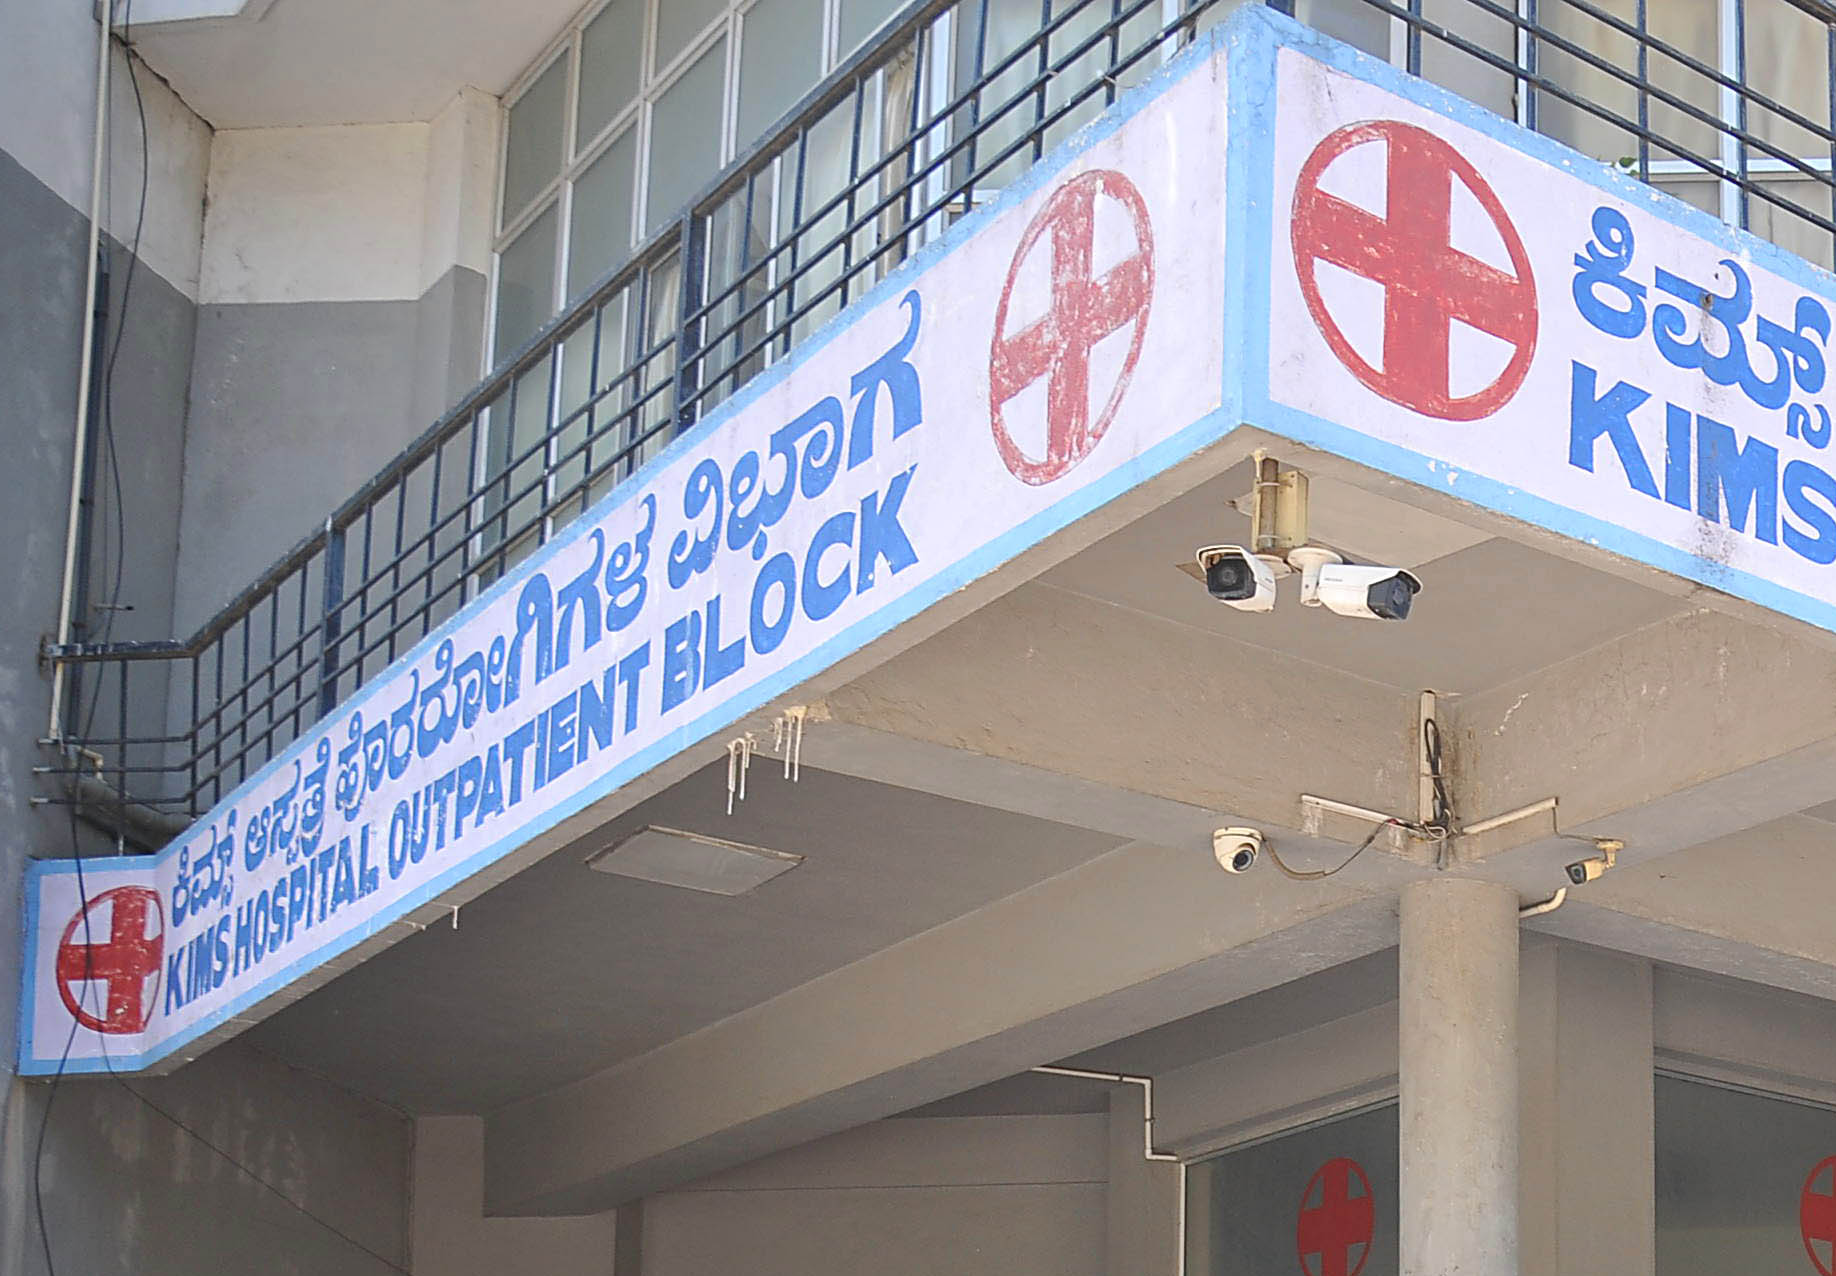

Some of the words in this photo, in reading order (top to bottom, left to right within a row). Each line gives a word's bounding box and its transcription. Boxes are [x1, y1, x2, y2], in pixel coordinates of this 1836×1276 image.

[245, 737, 331, 872] ಆಸ್ಪತ್ರೆ
[335, 493, 656, 822] ಹೊರರೋಗಿಗಳ
[668, 290, 922, 589] ವಿಭಾಗ
[1572, 207, 1832, 450] ಕಿಮ್ಸ್
[164, 914, 231, 1016] KIMS
[233, 824, 379, 978] HOSPITAL
[388, 642, 650, 880] OUTPATIENT
[661, 463, 919, 716] BLOCK
